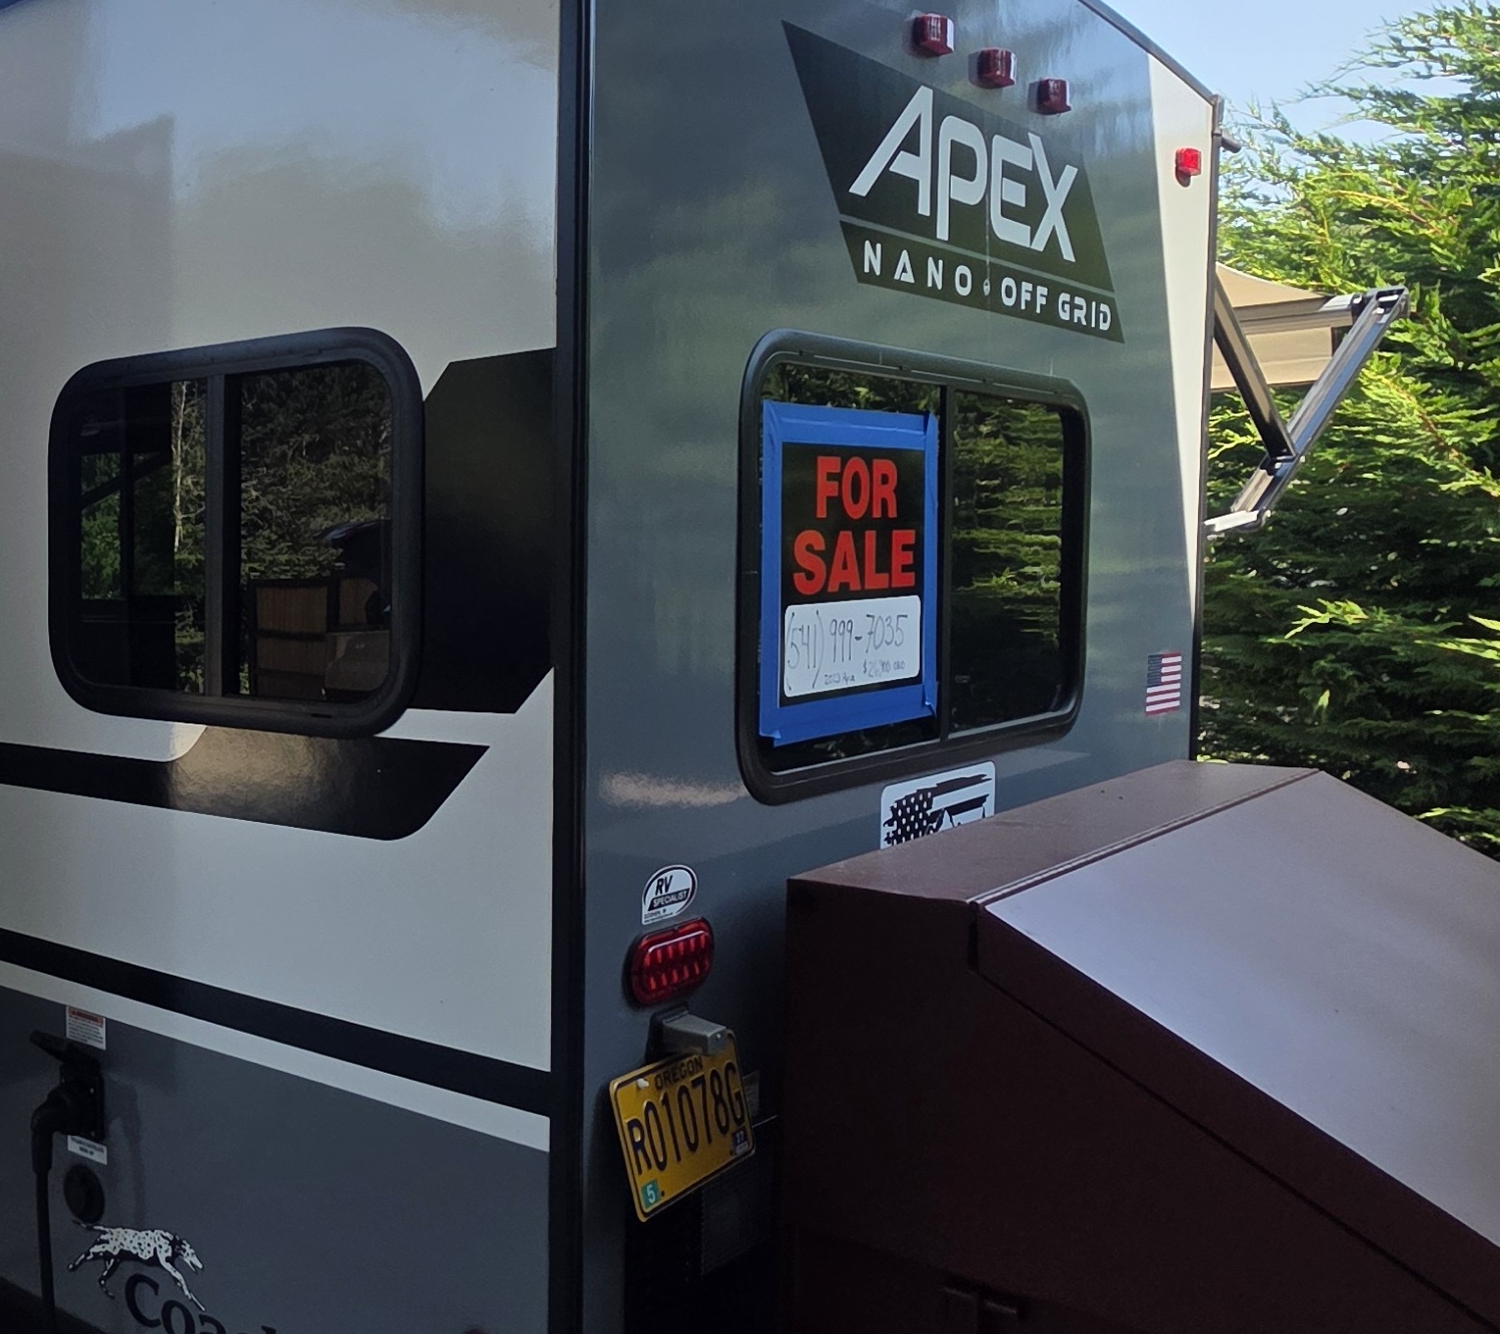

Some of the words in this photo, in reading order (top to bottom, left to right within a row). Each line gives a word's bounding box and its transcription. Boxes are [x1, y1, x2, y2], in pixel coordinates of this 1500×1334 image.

[849, 85, 1078, 262] APEX
[864, 240, 972, 296] NANO
[1001, 277, 1048, 314] OFF
[1058, 292, 1111, 331] GRID
[816, 456, 897, 519] FOR
[793, 529, 915, 595] SALE
[652, 890, 687, 908] SPECIALIST
[655, 874, 673, 896] RV
[654, 1055, 703, 1091] OREGON
[627, 1061, 746, 1176] R01078G
[645, 1183, 657, 1204] 5
